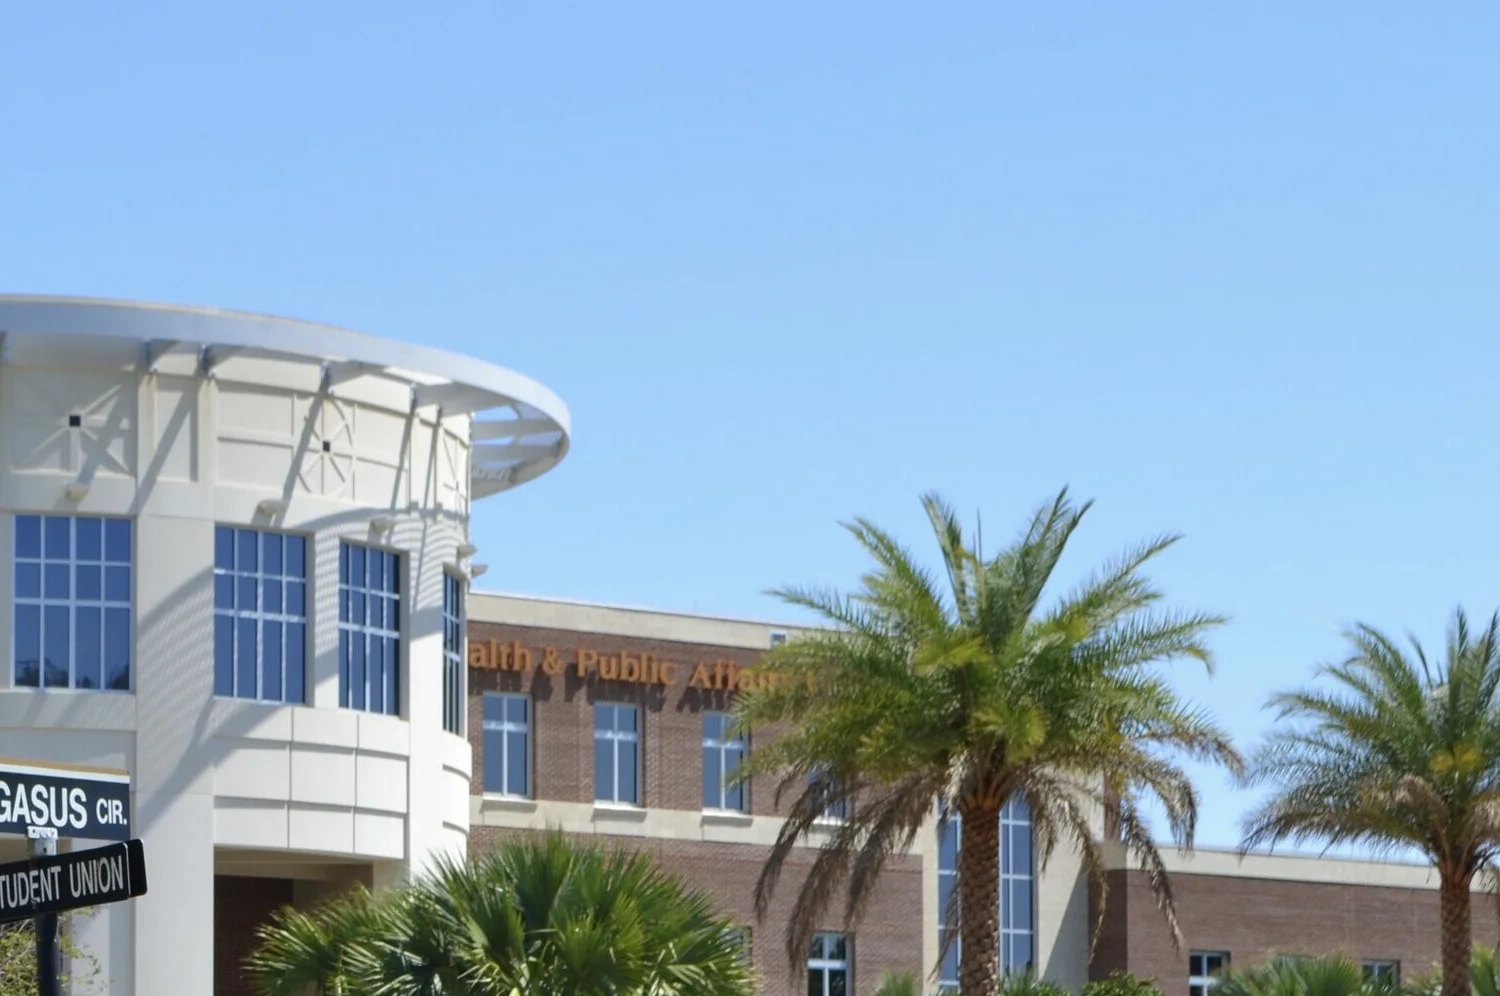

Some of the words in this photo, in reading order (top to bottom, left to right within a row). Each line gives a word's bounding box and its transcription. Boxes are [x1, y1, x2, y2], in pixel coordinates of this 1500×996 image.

[542, 646, 562, 675] &
[576, 648, 678, 686] Public
[96, 798, 128, 826] CIR.
[69, 854, 124, 899] UNION
